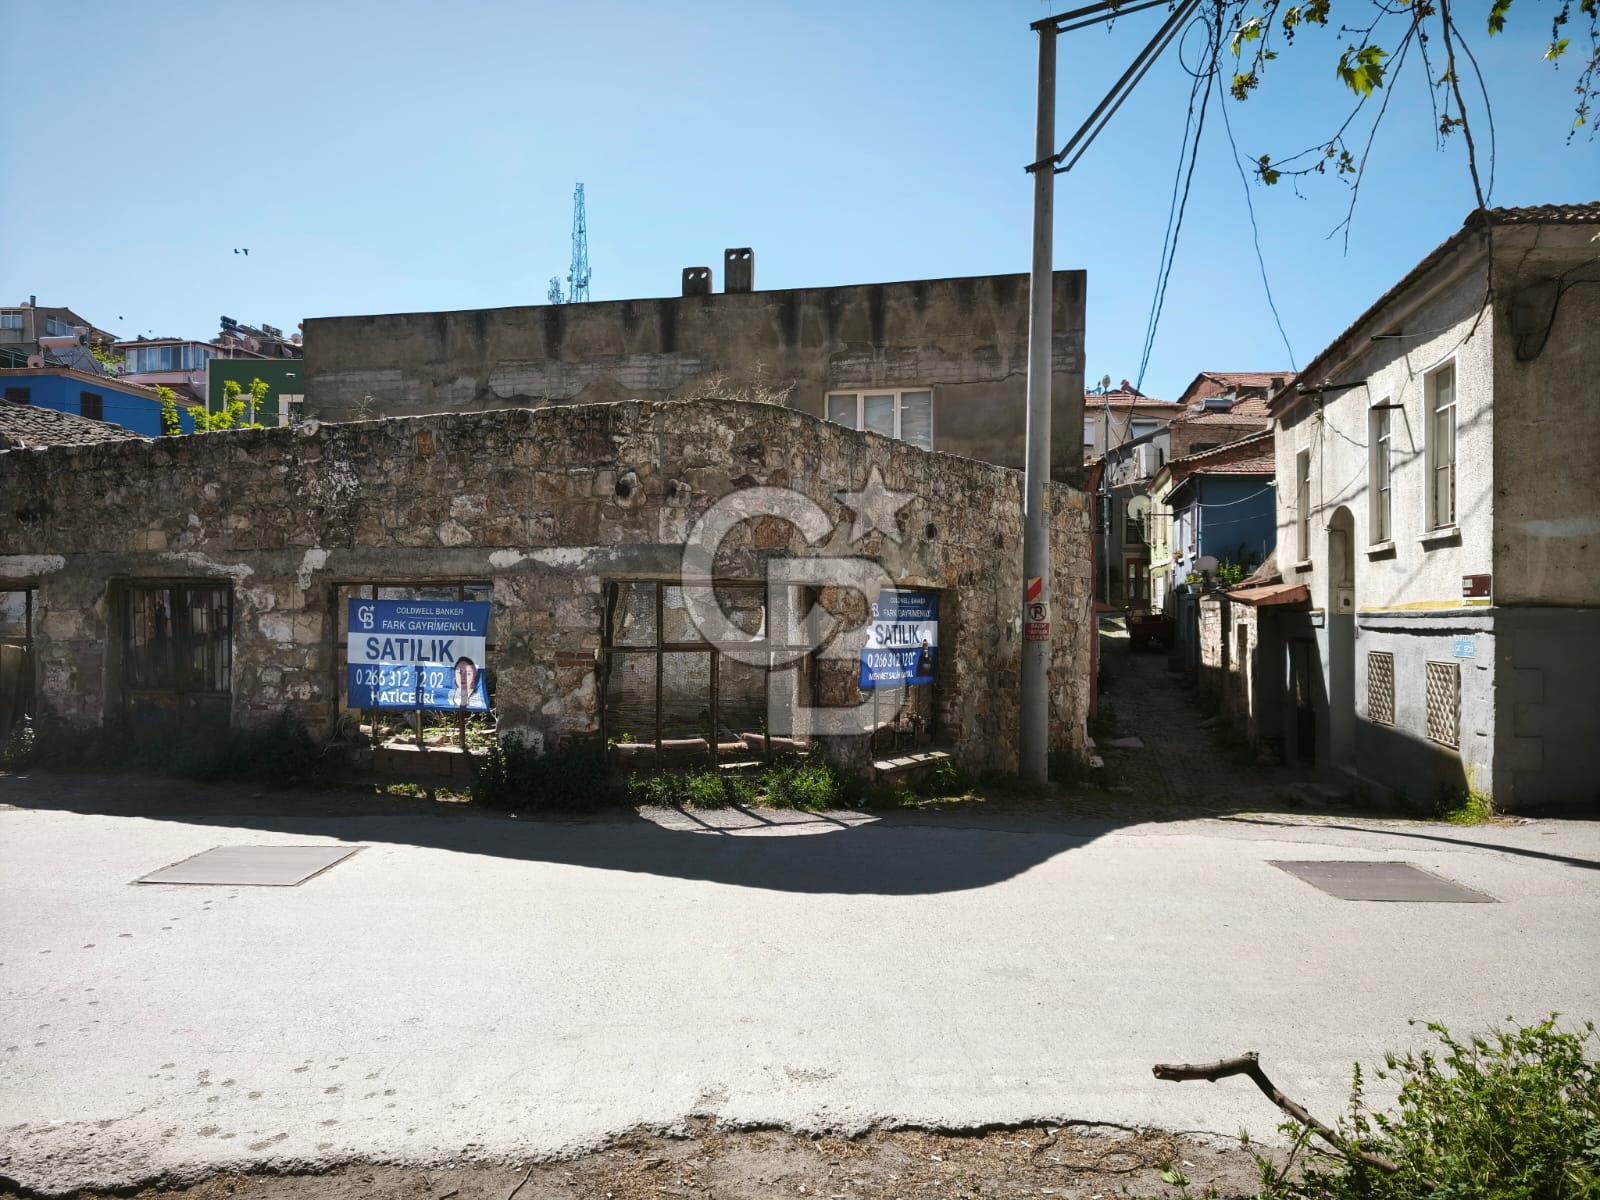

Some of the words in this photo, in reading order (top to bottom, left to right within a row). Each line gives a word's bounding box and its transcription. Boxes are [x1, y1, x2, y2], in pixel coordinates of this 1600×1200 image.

[396, 607, 434, 615] COLDWELL
[435, 607, 464, 616] BANKER
[382, 620, 405, 630] FARK
[408, 620, 477, 632] GAYRİMENKUL
[875, 623, 920, 645] SATILIK
[366, 637, 454, 663] SATILIK
[867, 654, 873, 668] 0
[874, 653, 888, 668] 266
[888, 652, 900, 668] 312
[356, 668, 363, 685] 0
[365, 669, 385, 686] 266
[388, 670, 410, 687] 312
[415, 671, 427, 688] 12
[429, 671, 444, 689] 02
[371, 688, 416, 704] HATİCE
